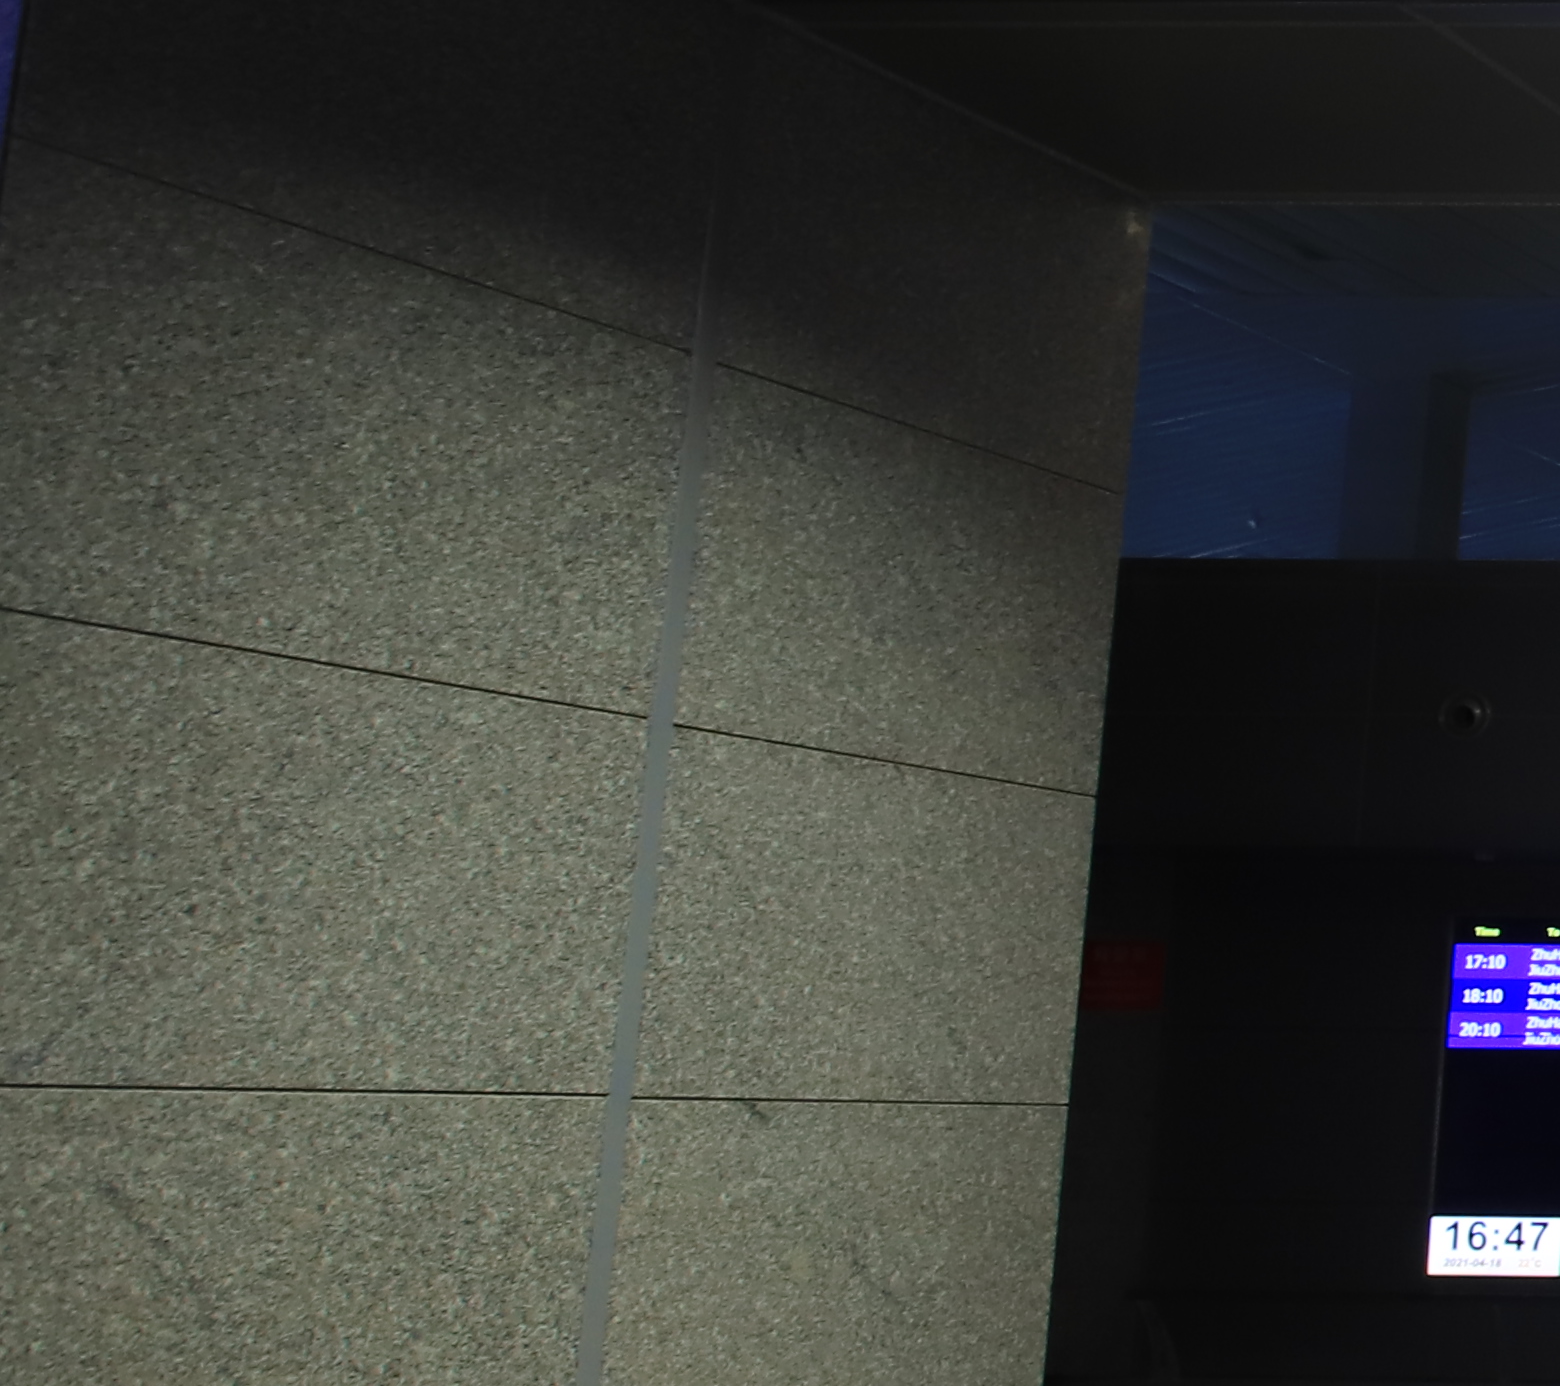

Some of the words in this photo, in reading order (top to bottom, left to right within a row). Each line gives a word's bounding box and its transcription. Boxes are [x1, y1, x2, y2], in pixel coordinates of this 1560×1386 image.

[1465, 954, 1507, 969] 17:10
[1462, 988, 1504, 1003] 18:10
[1459, 1022, 1502, 1037] 20:10
[1446, 1221, 1549, 1251] 16:47
[1443, 1258, 1501, 1268] 2021-04-18
